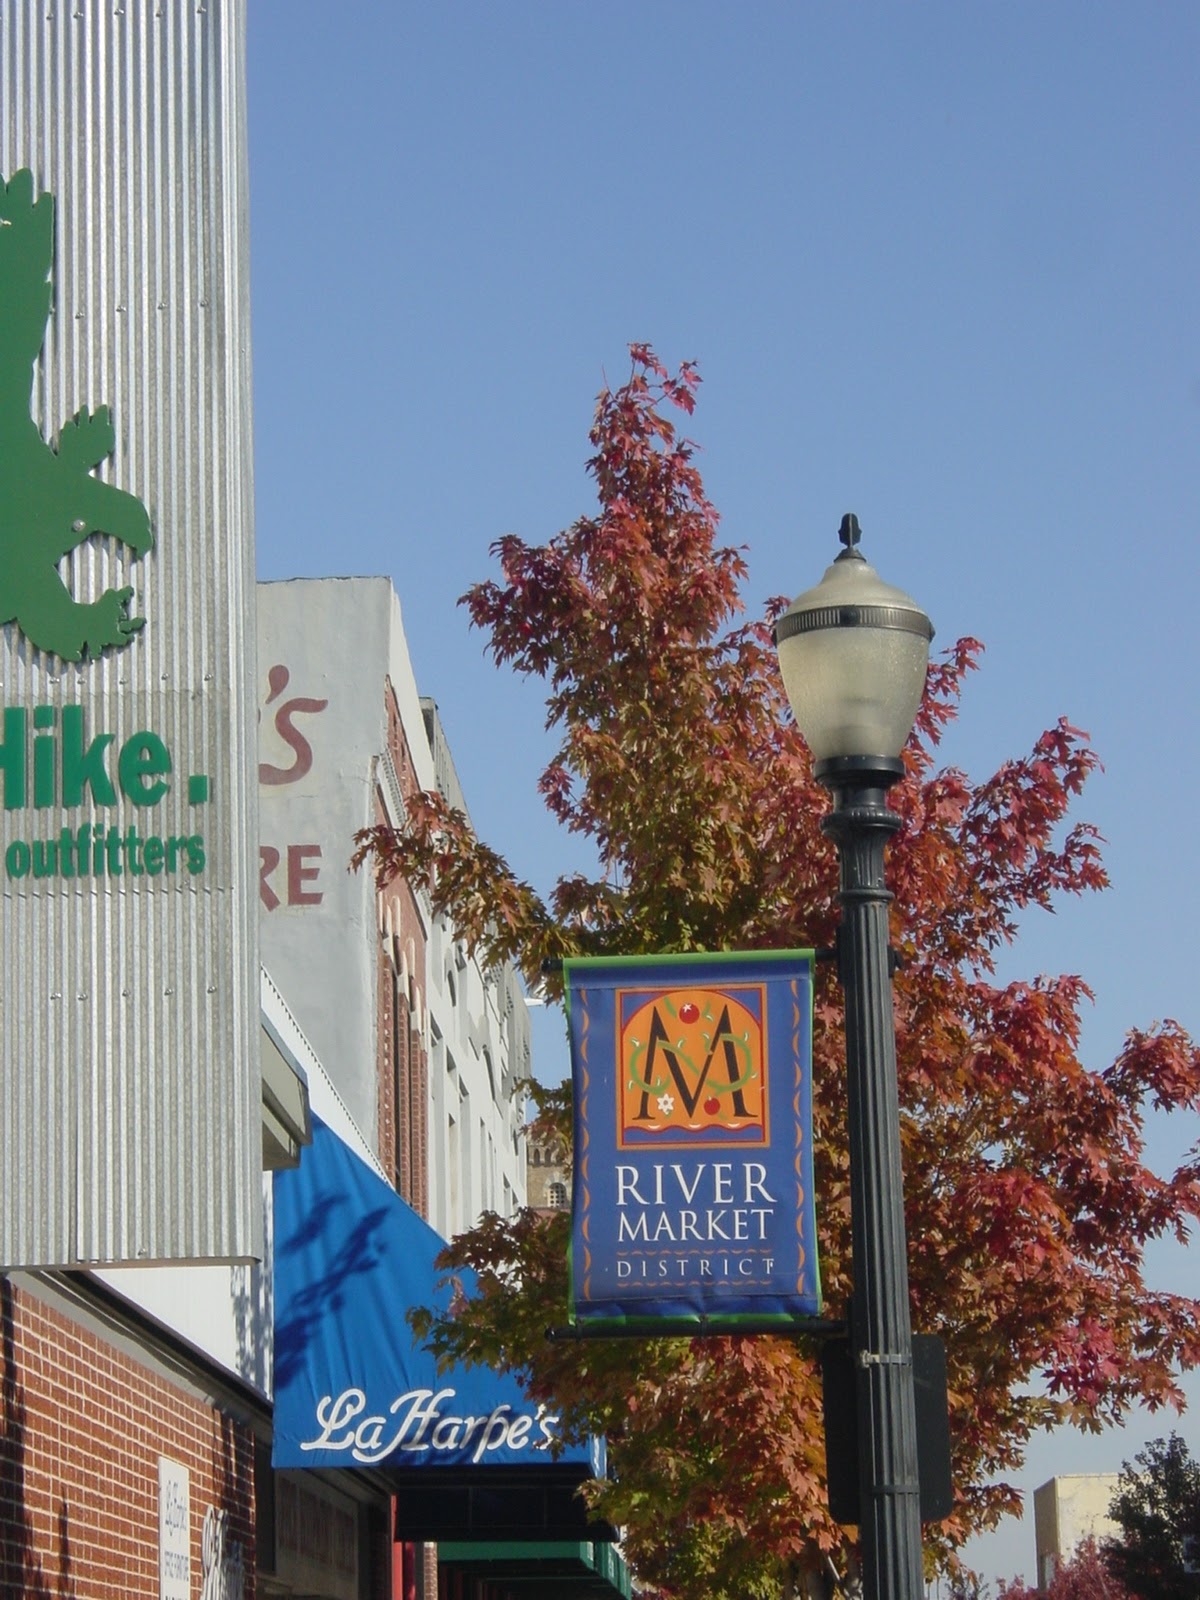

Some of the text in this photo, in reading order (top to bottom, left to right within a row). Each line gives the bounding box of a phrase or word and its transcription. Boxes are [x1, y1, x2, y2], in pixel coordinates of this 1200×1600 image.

[5, 822, 206, 879] outfitters
[615, 1163, 777, 1206] RIVER
[617, 1209, 774, 1242] MARKET
[617, 1258, 775, 1278] DISTRICT
[300, 1388, 559, 1463] La Harpe's
